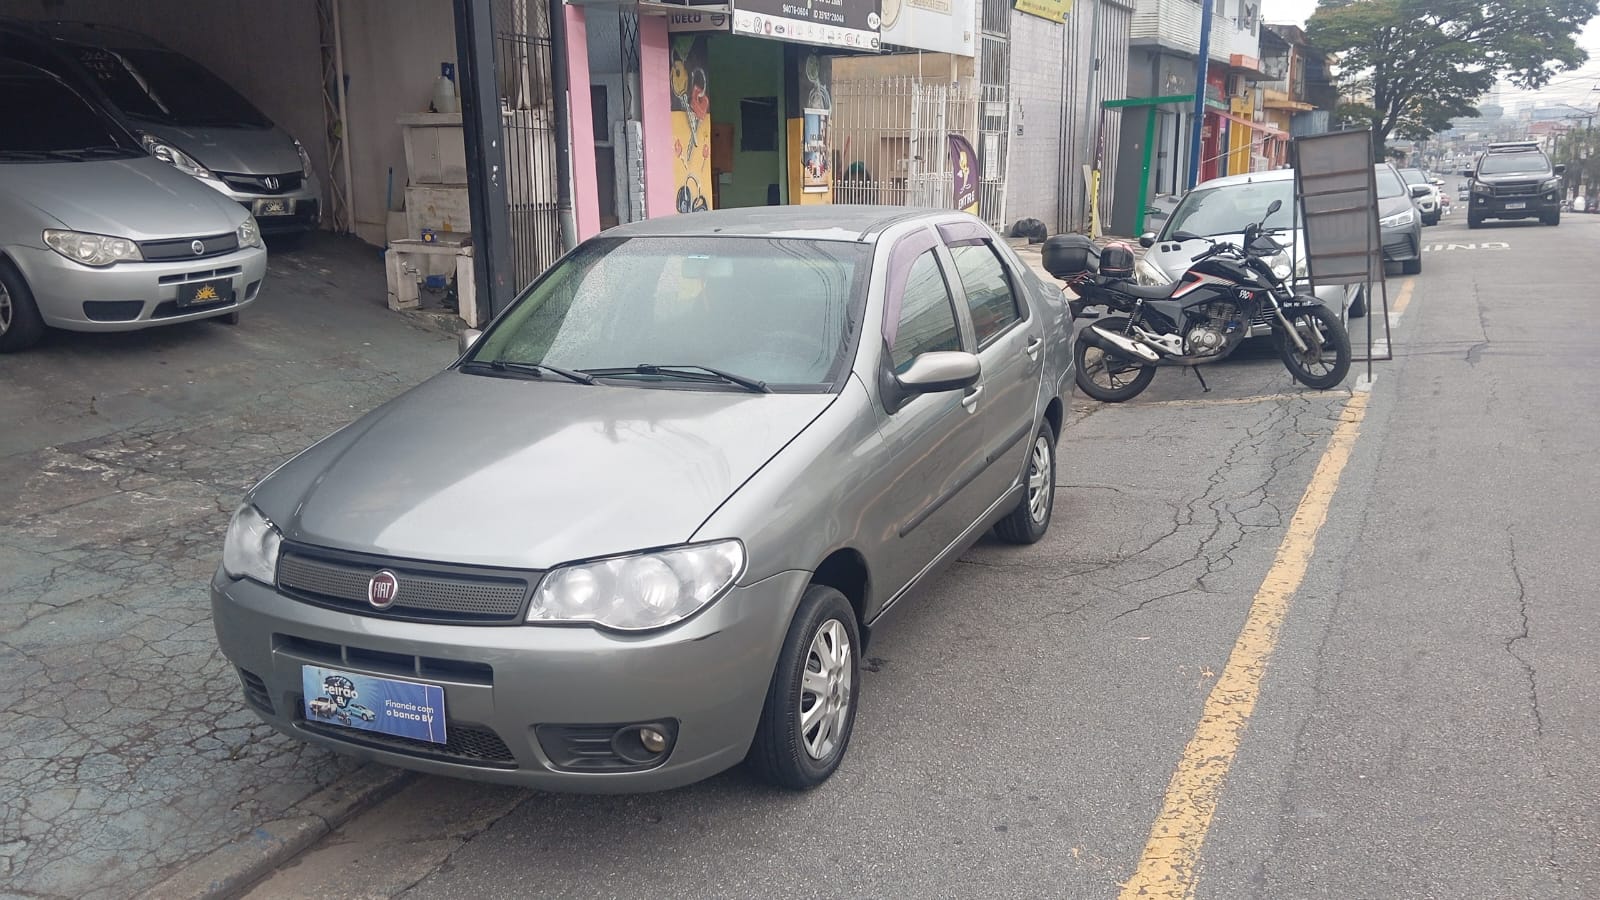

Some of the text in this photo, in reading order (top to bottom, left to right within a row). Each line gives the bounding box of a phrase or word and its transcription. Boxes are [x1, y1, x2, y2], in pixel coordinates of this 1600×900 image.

[671, 13, 702, 24] IVECO
[958, 190, 975, 210] ENTRE
[373, 581, 392, 599] FIAT
[322, 683, 359, 700] Feirão
[385, 699, 434, 714] Financie com
[386, 709, 433, 723] o banco BV
